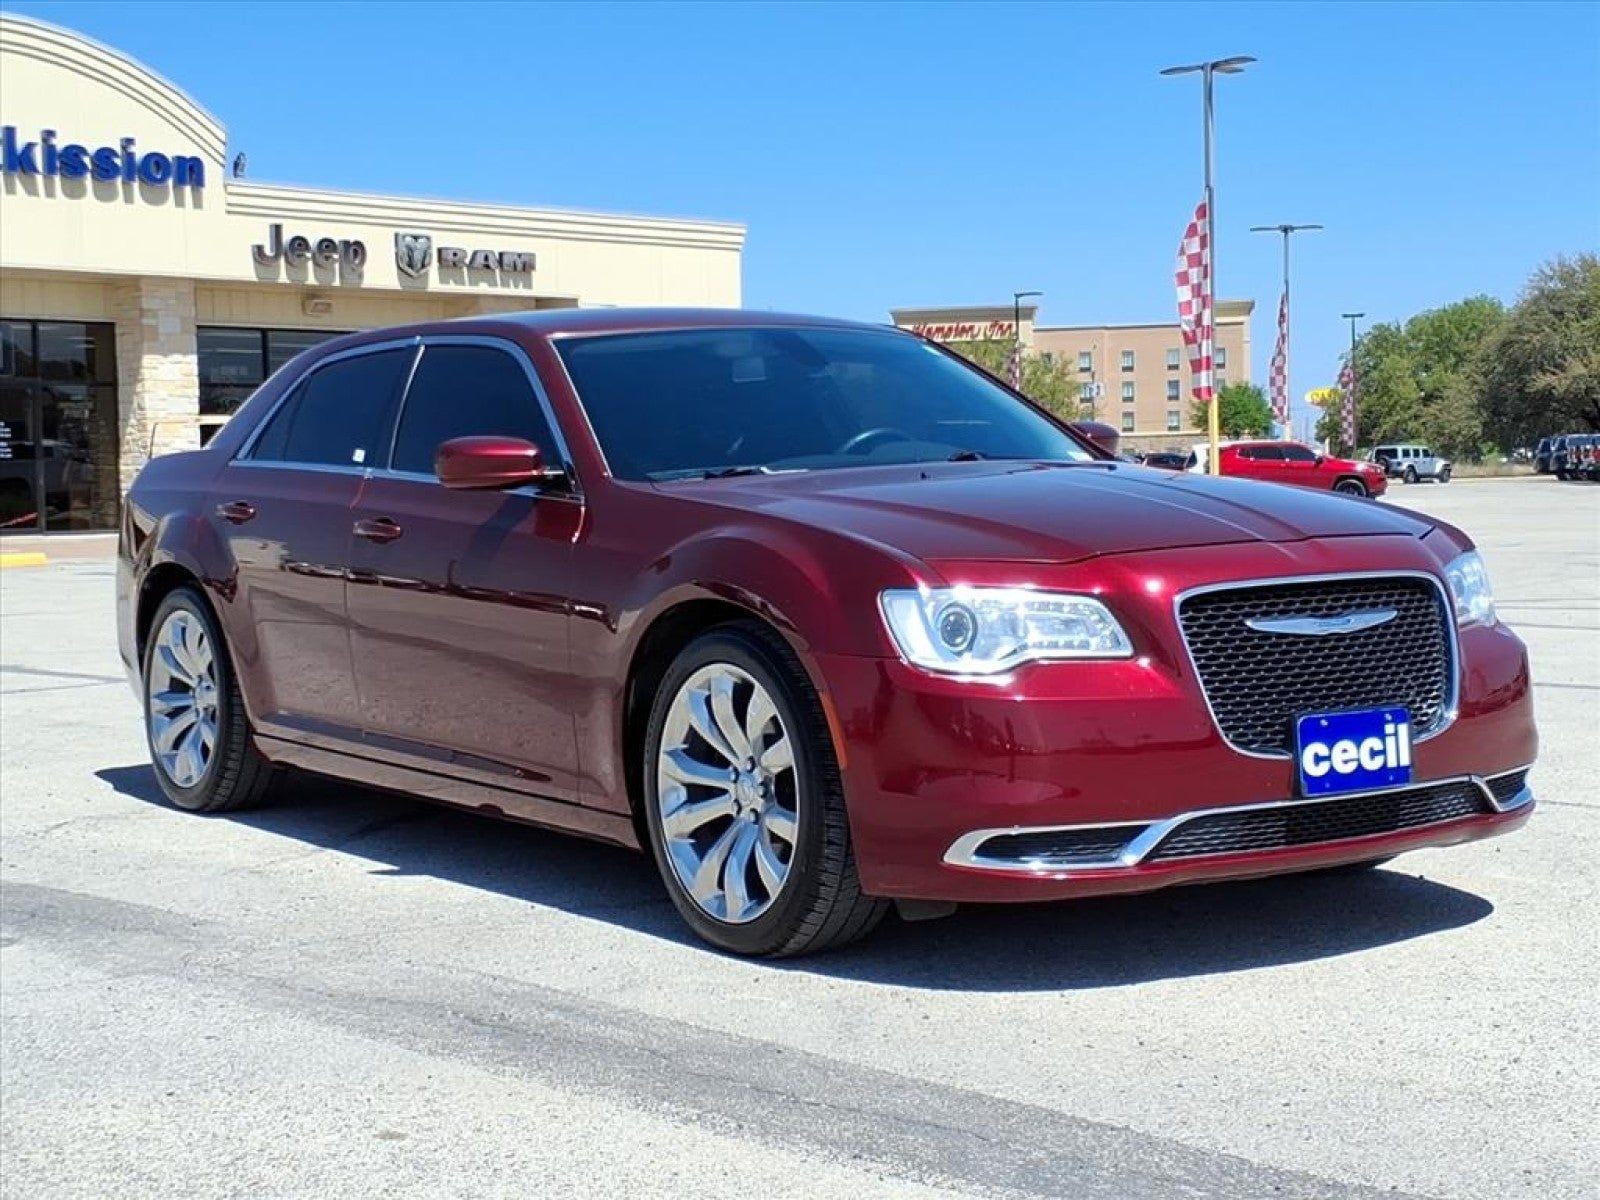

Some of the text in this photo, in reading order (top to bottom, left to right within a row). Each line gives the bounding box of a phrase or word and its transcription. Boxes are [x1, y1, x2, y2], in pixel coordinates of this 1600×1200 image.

[0, 125, 206, 188] kission
[252, 223, 367, 273] Jeep
[437, 246, 536, 273] RAM
[988, 319, 1014, 337] Inn
[1302, 723, 1411, 778] cecil
